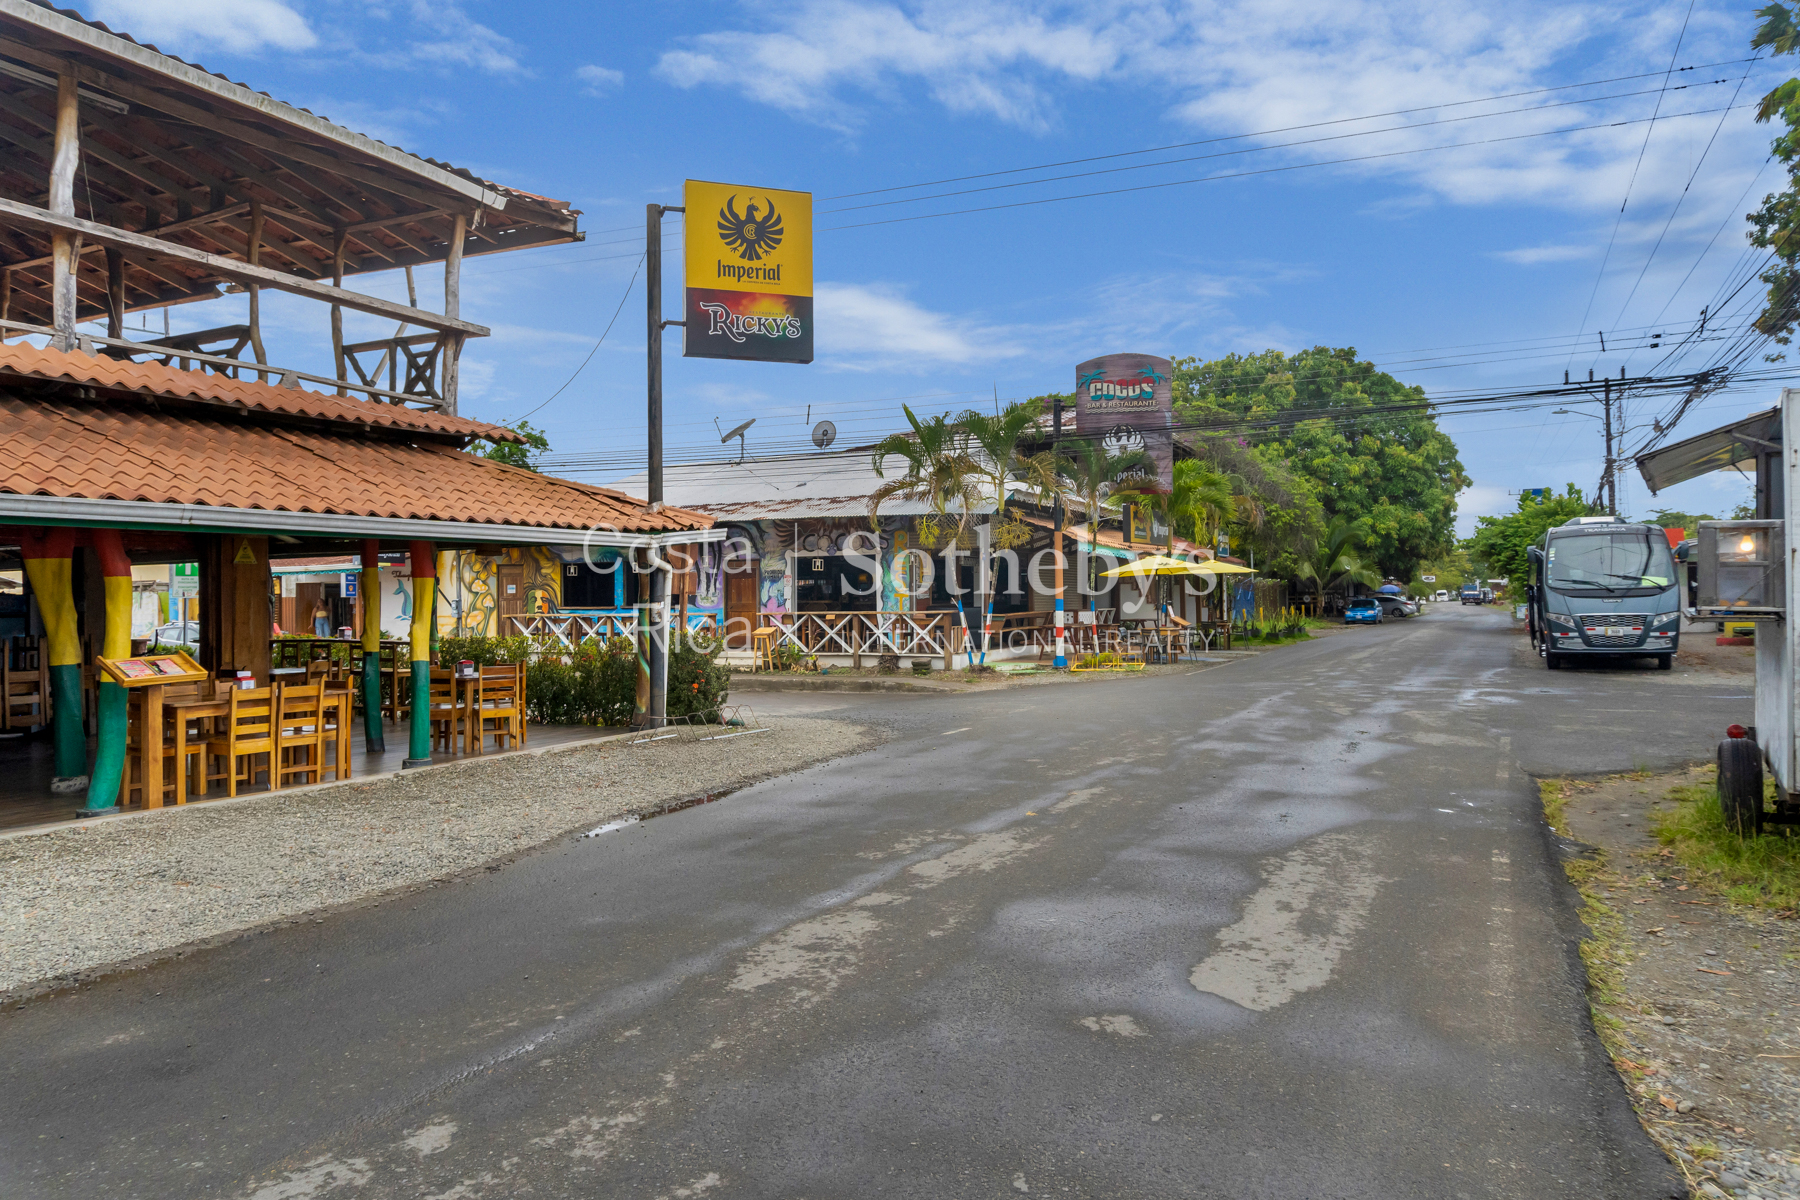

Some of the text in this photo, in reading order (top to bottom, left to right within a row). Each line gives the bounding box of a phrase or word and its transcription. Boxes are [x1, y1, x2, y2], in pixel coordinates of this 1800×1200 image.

[717, 259, 781, 283] Imperial
[1089, 376, 1154, 400] COCOS
[1108, 400, 1157, 408] RESTAURANTE
